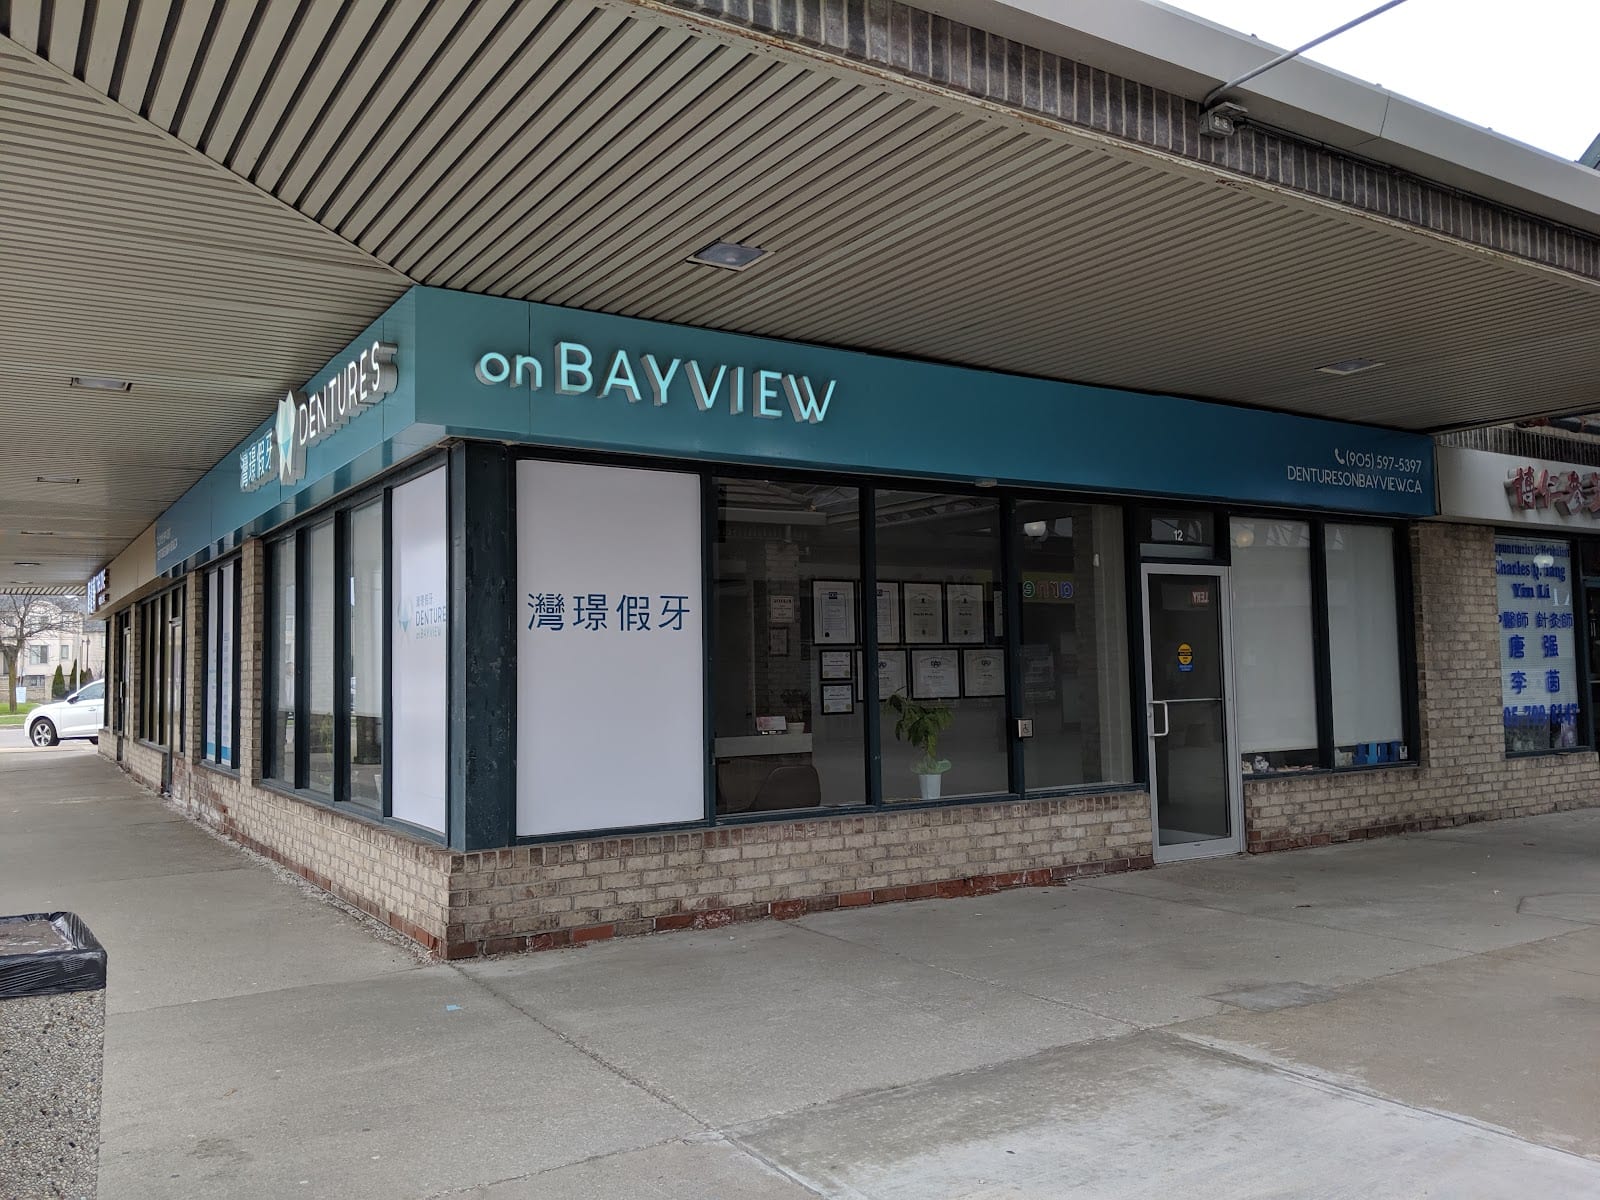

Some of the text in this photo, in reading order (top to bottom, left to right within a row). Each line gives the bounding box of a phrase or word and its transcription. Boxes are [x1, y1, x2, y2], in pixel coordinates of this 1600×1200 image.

[299, 340, 381, 446] DENTURES
[477, 341, 838, 423] on BAYVIEW
[1346, 450, 1422, 474] (905) 597-5397
[1287, 465, 1423, 494] DENTURESONBAYVIEW.CA
[1174, 529, 1183, 542] 12
[1537, 583, 1551, 598] Li
[416, 607, 446, 626] DENTURE
[527, 593, 691, 632] 灣璟假牙
